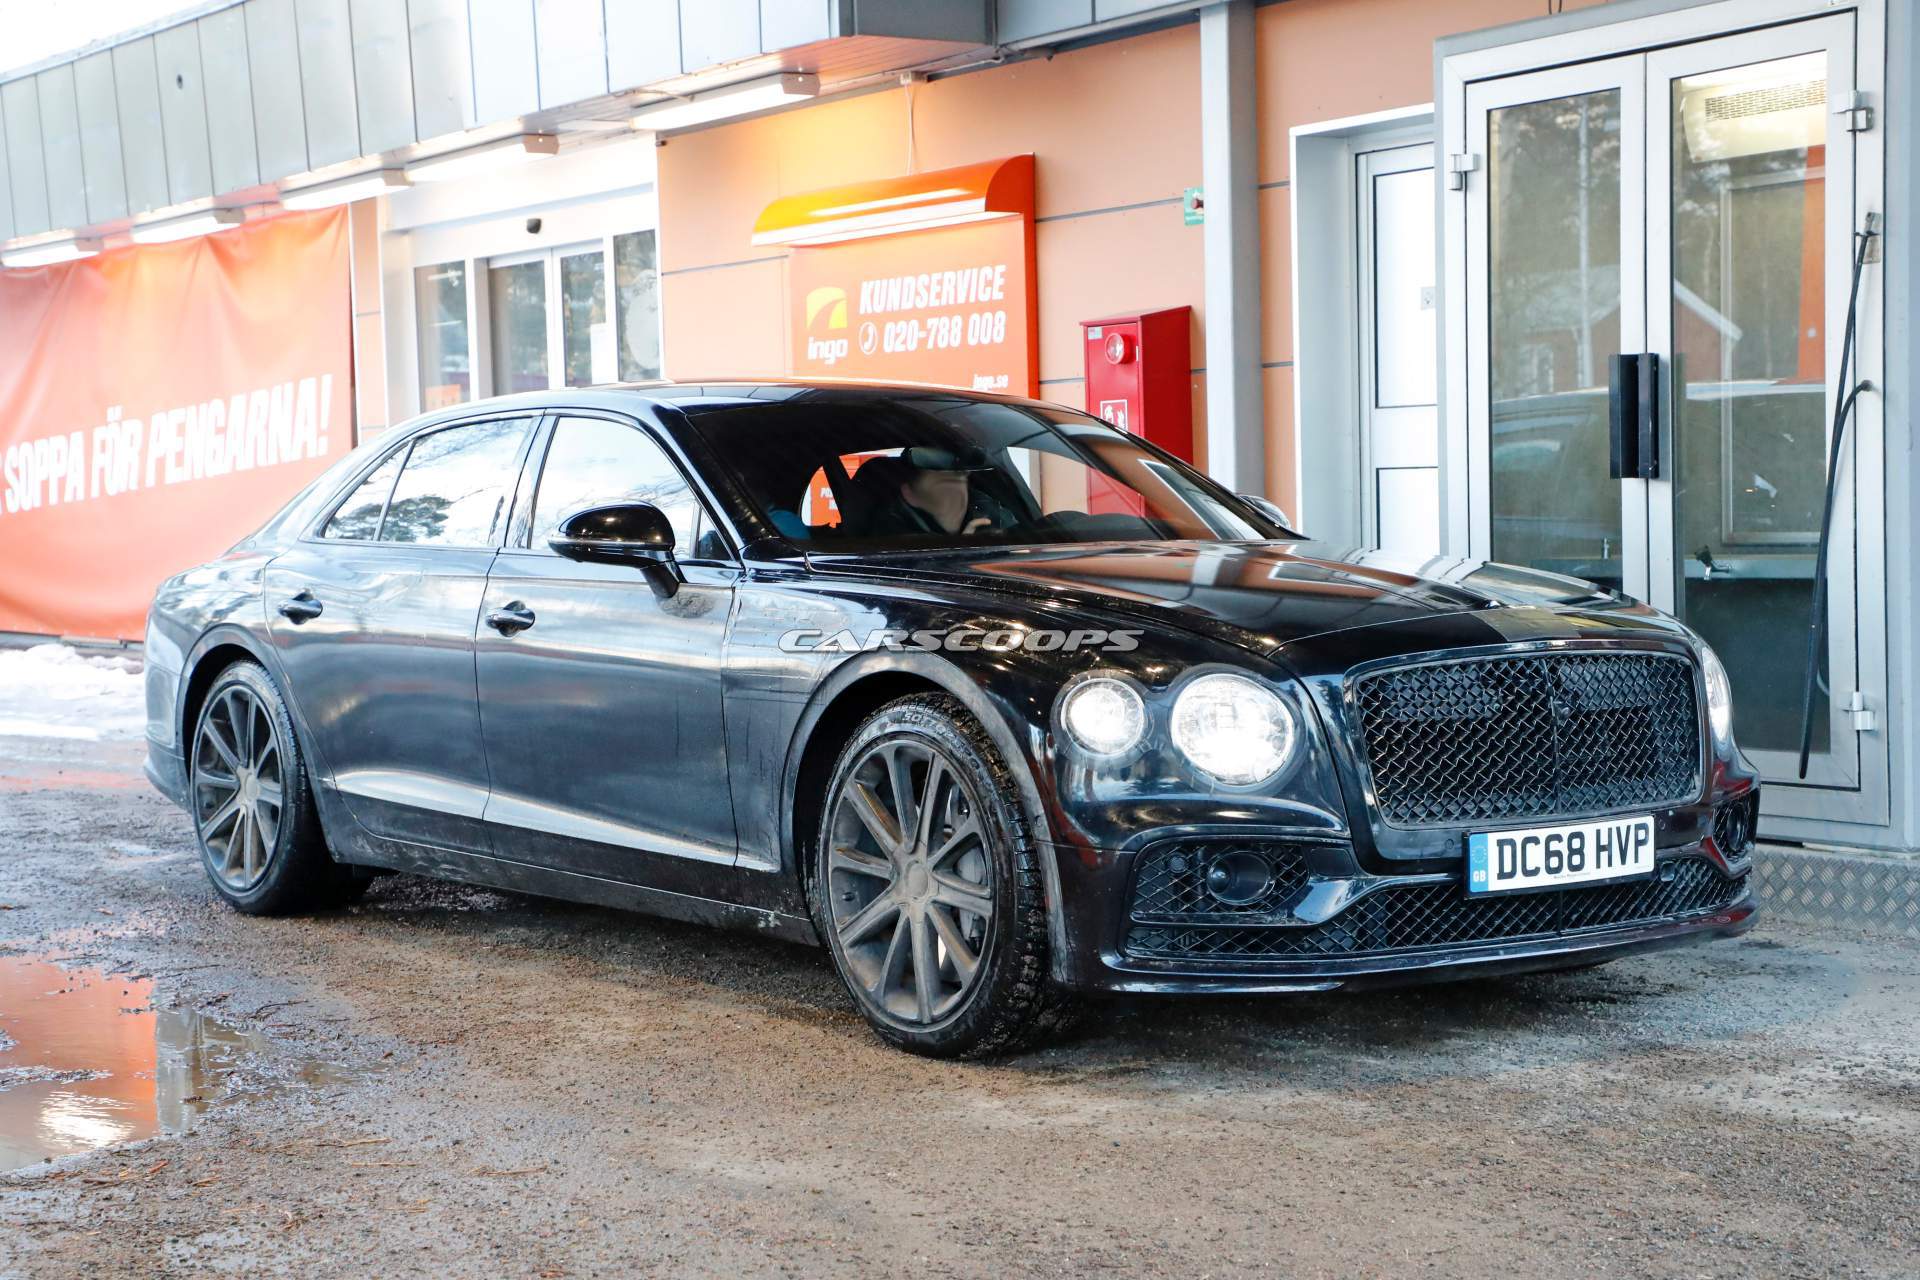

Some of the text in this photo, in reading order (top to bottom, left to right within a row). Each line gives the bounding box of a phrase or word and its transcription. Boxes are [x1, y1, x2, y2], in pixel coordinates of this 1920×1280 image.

[858, 264, 1006, 315] KUNDSERVICE
[807, 336, 848, 364] ingo
[882, 310, 1007, 353] 020-788 008
[4, 430, 85, 513] SOPPA
[91, 404, 143, 498] FÖR
[145, 373, 333, 488] PENGARNA!
[1496, 822, 1650, 880] DC68 HVP
[1472, 870, 1487, 882] GB
